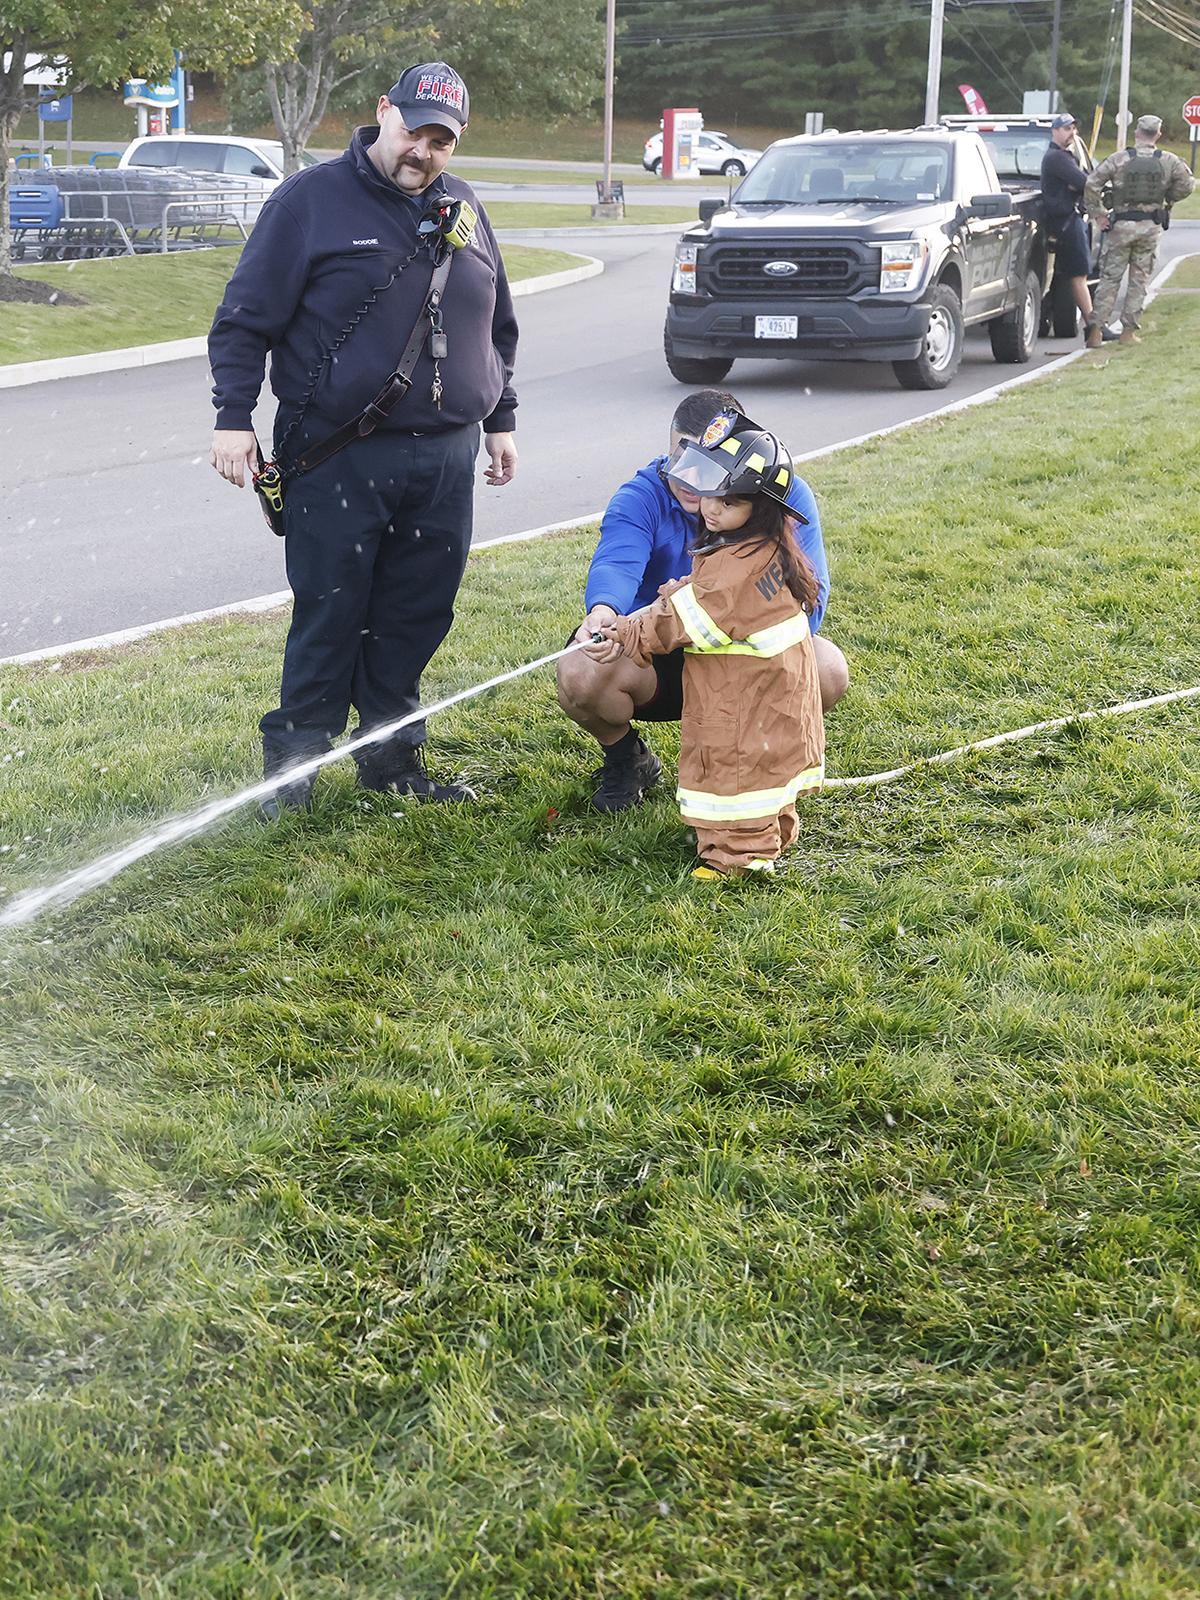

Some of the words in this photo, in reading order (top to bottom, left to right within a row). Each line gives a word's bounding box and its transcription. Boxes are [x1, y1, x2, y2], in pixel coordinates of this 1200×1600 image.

[421, 74, 444, 82] WEST
[417, 80, 463, 105] FIRE
[415, 93, 463, 111] DEPARTMEN
[1185, 105, 1200, 118] STO
[755, 555, 785, 602] WE
